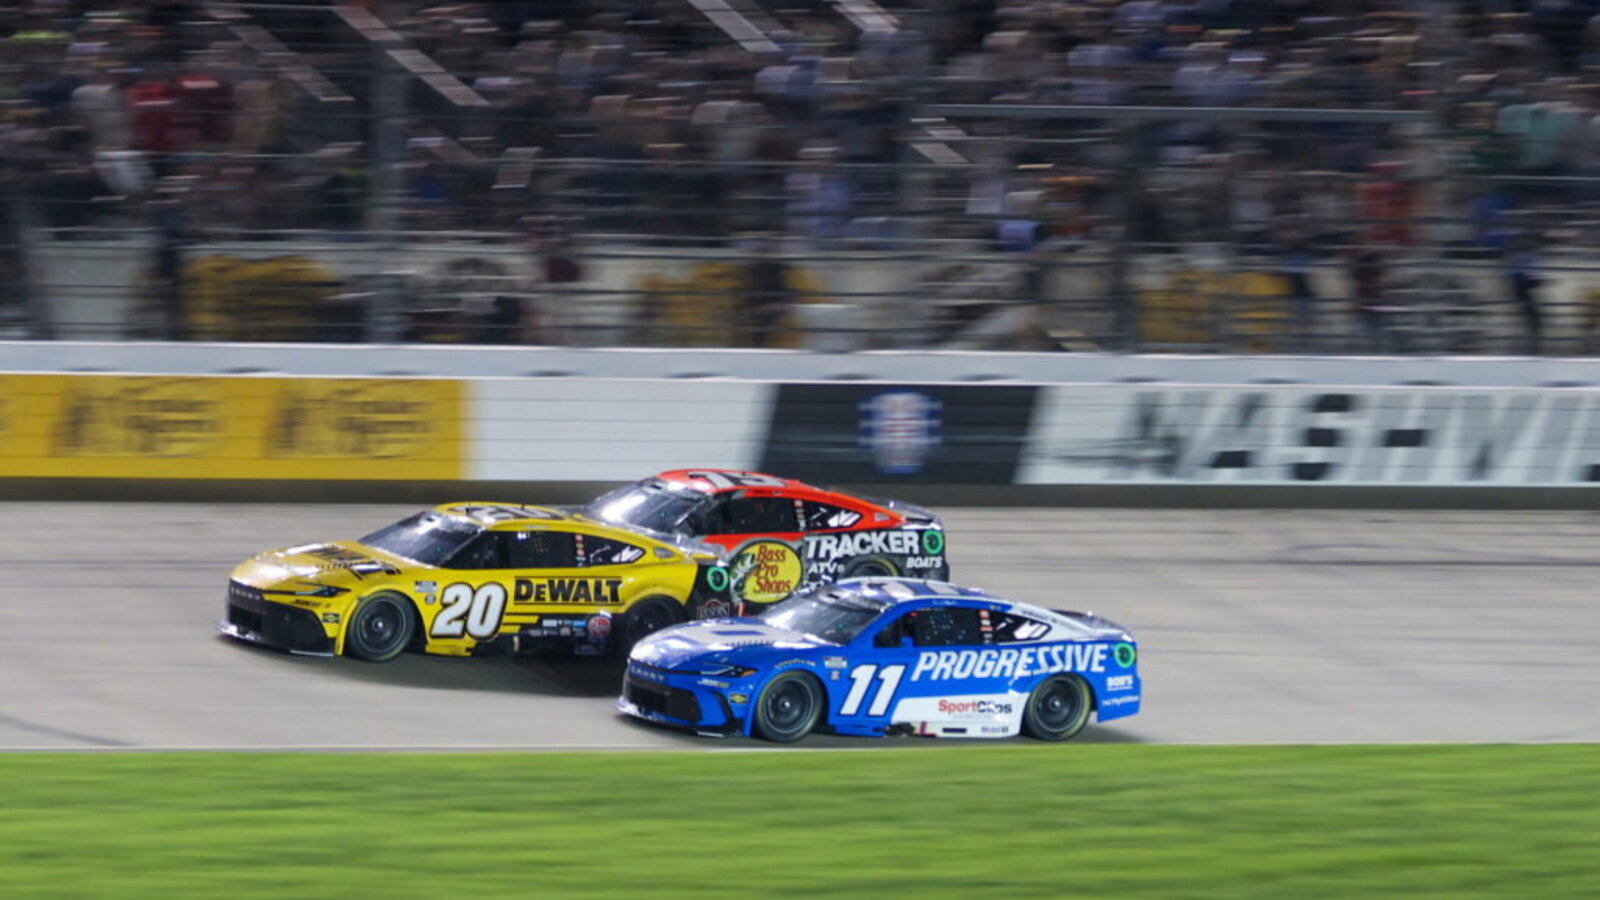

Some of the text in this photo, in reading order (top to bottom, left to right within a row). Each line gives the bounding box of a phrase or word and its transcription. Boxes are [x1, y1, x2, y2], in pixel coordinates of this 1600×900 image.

[758, 545, 786, 561] Bass
[804, 531, 919, 559] TRACKER
[756, 563, 778, 577] Pro
[906, 557, 942, 568] BOATS
[753, 576, 791, 593] Shops
[430, 583, 507, 639] 20
[910, 644, 1109, 681] PROGRESSIVE
[840, 664, 906, 716] 11
